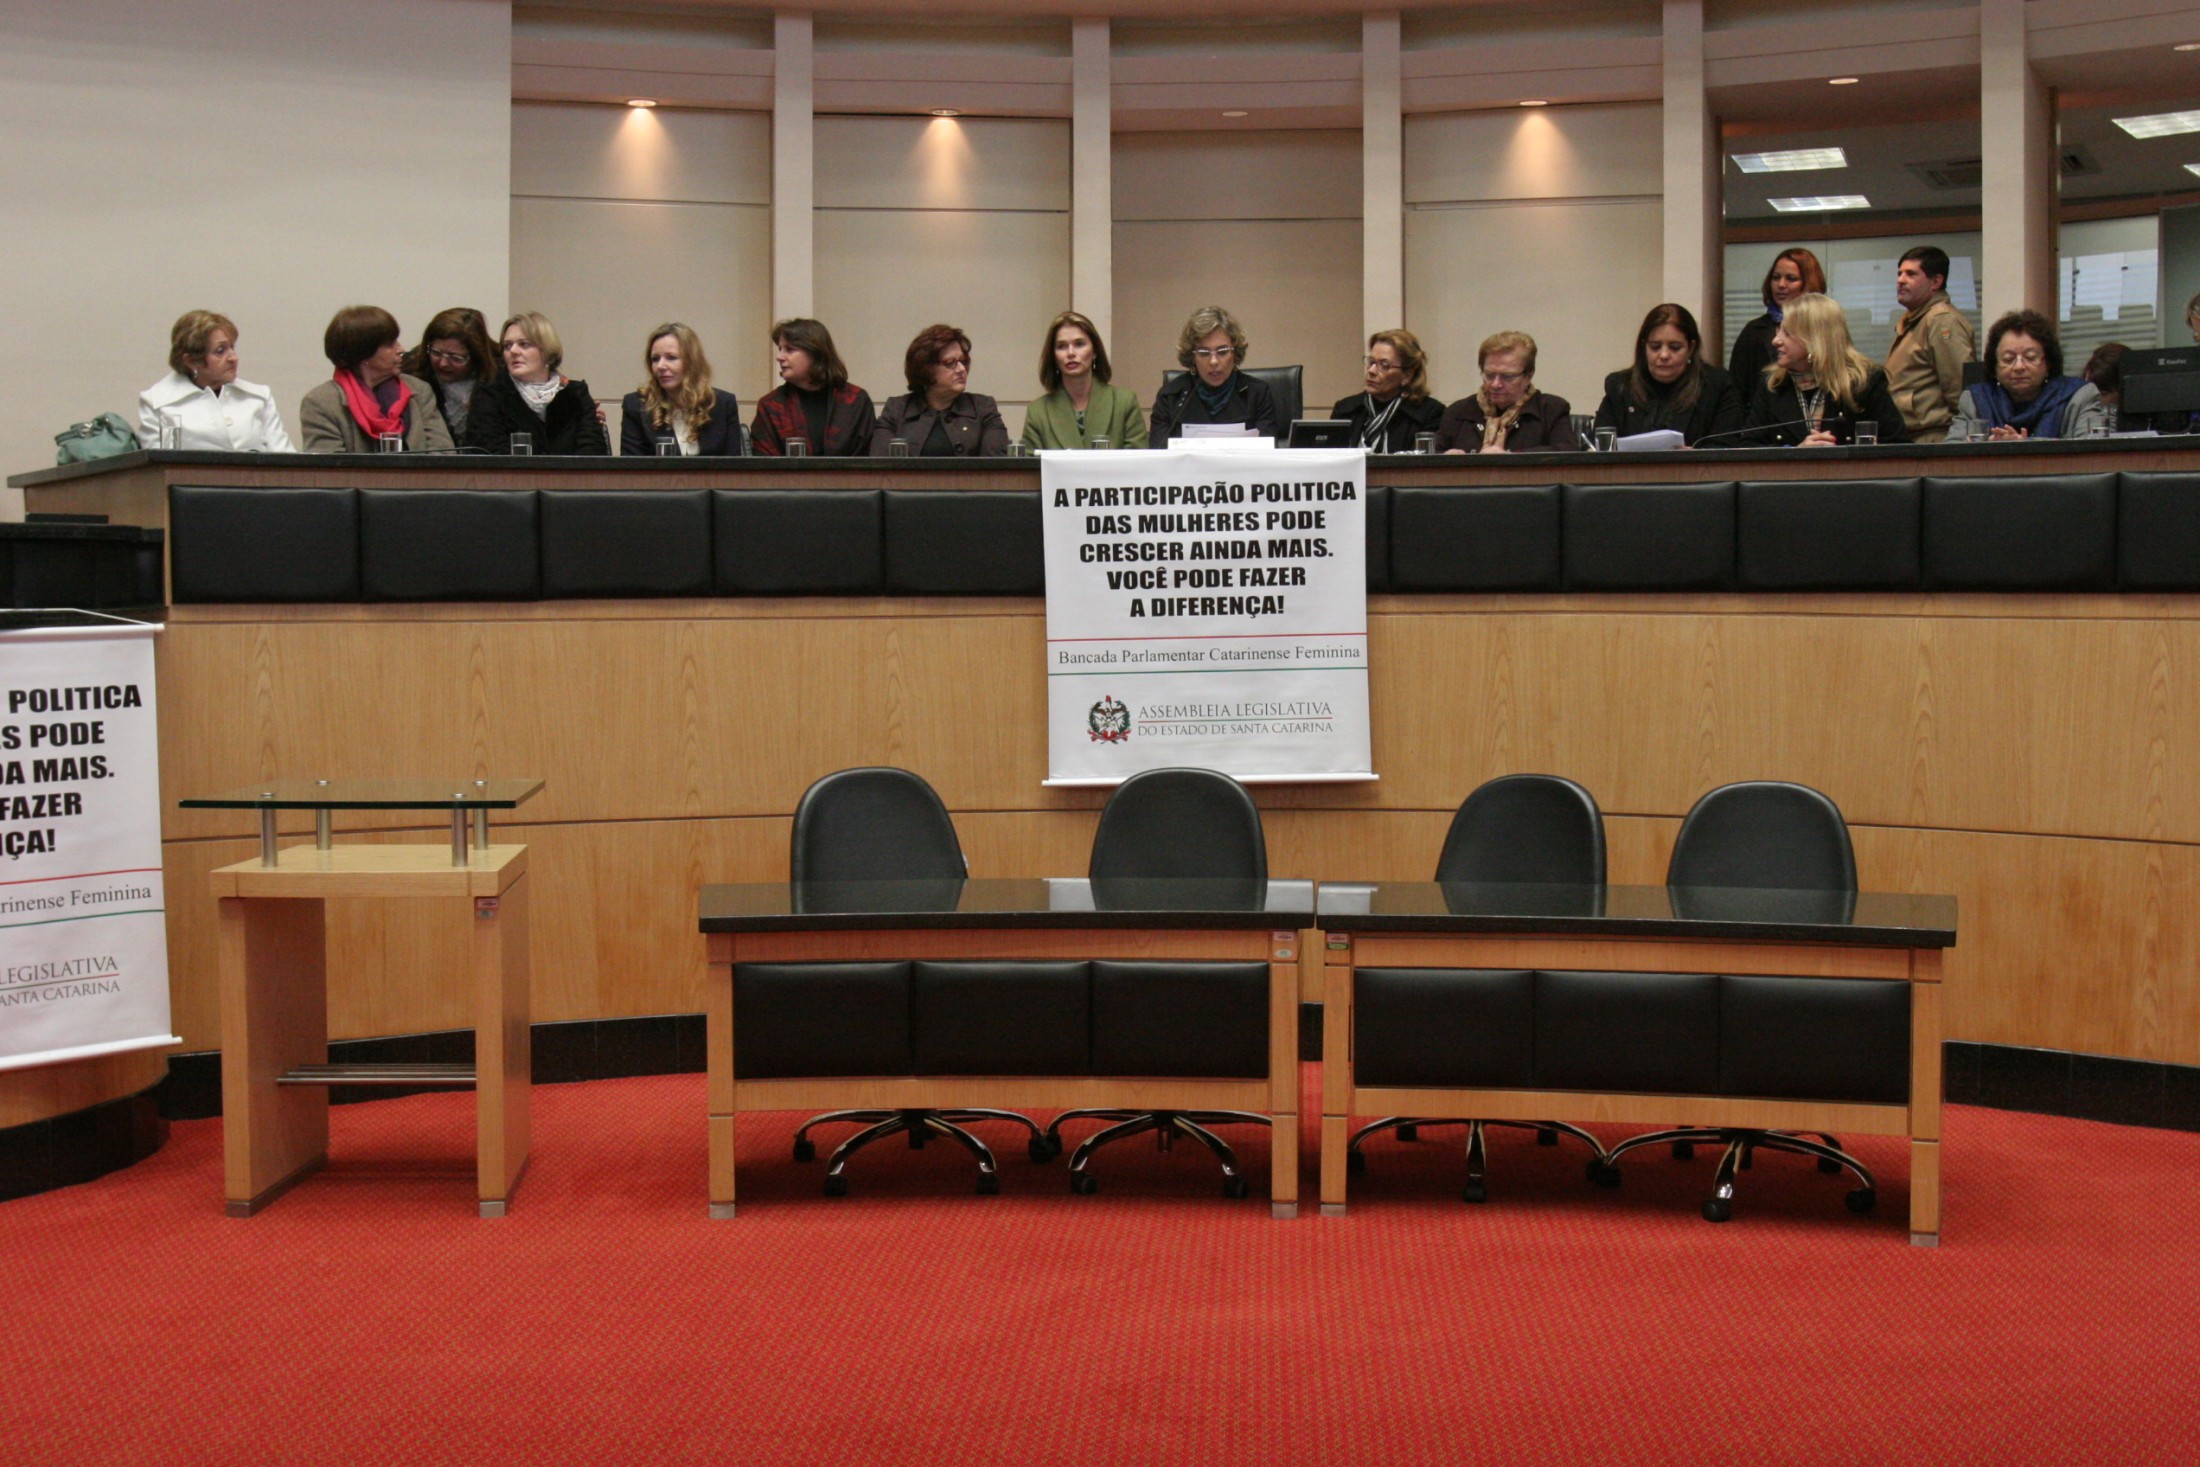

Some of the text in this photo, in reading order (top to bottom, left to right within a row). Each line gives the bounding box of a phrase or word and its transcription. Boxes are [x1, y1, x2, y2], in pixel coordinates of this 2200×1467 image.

[1054, 481, 1356, 508] A PARTICIPAÇÃO POLITICA
[1086, 510, 1325, 534] DAS MULHERES PODE
[1080, 538, 1333, 563] CRESCER AINDA MAIS.
[1107, 567, 1305, 589] VOCÊ PODE FAZER
[1130, 596, 1284, 618] A DIFERENÇA!
[1059, 645, 1361, 665] Bancada Parlamentar Catarinense Feminina
[9, 685, 141, 713] POLITICA
[1138, 701, 1333, 719] ASSEMBLEIA LEGISLATIVA
[30, 721, 104, 748] PODE
[1138, 722, 1333, 736] DO ESTADO DE SANTA CATARINA
[33, 755, 114, 783] MAIS.
[0, 793, 82, 821] FAZER
[70, 884, 152, 906] Feminina
[42, 980, 121, 1001] CATARINA
